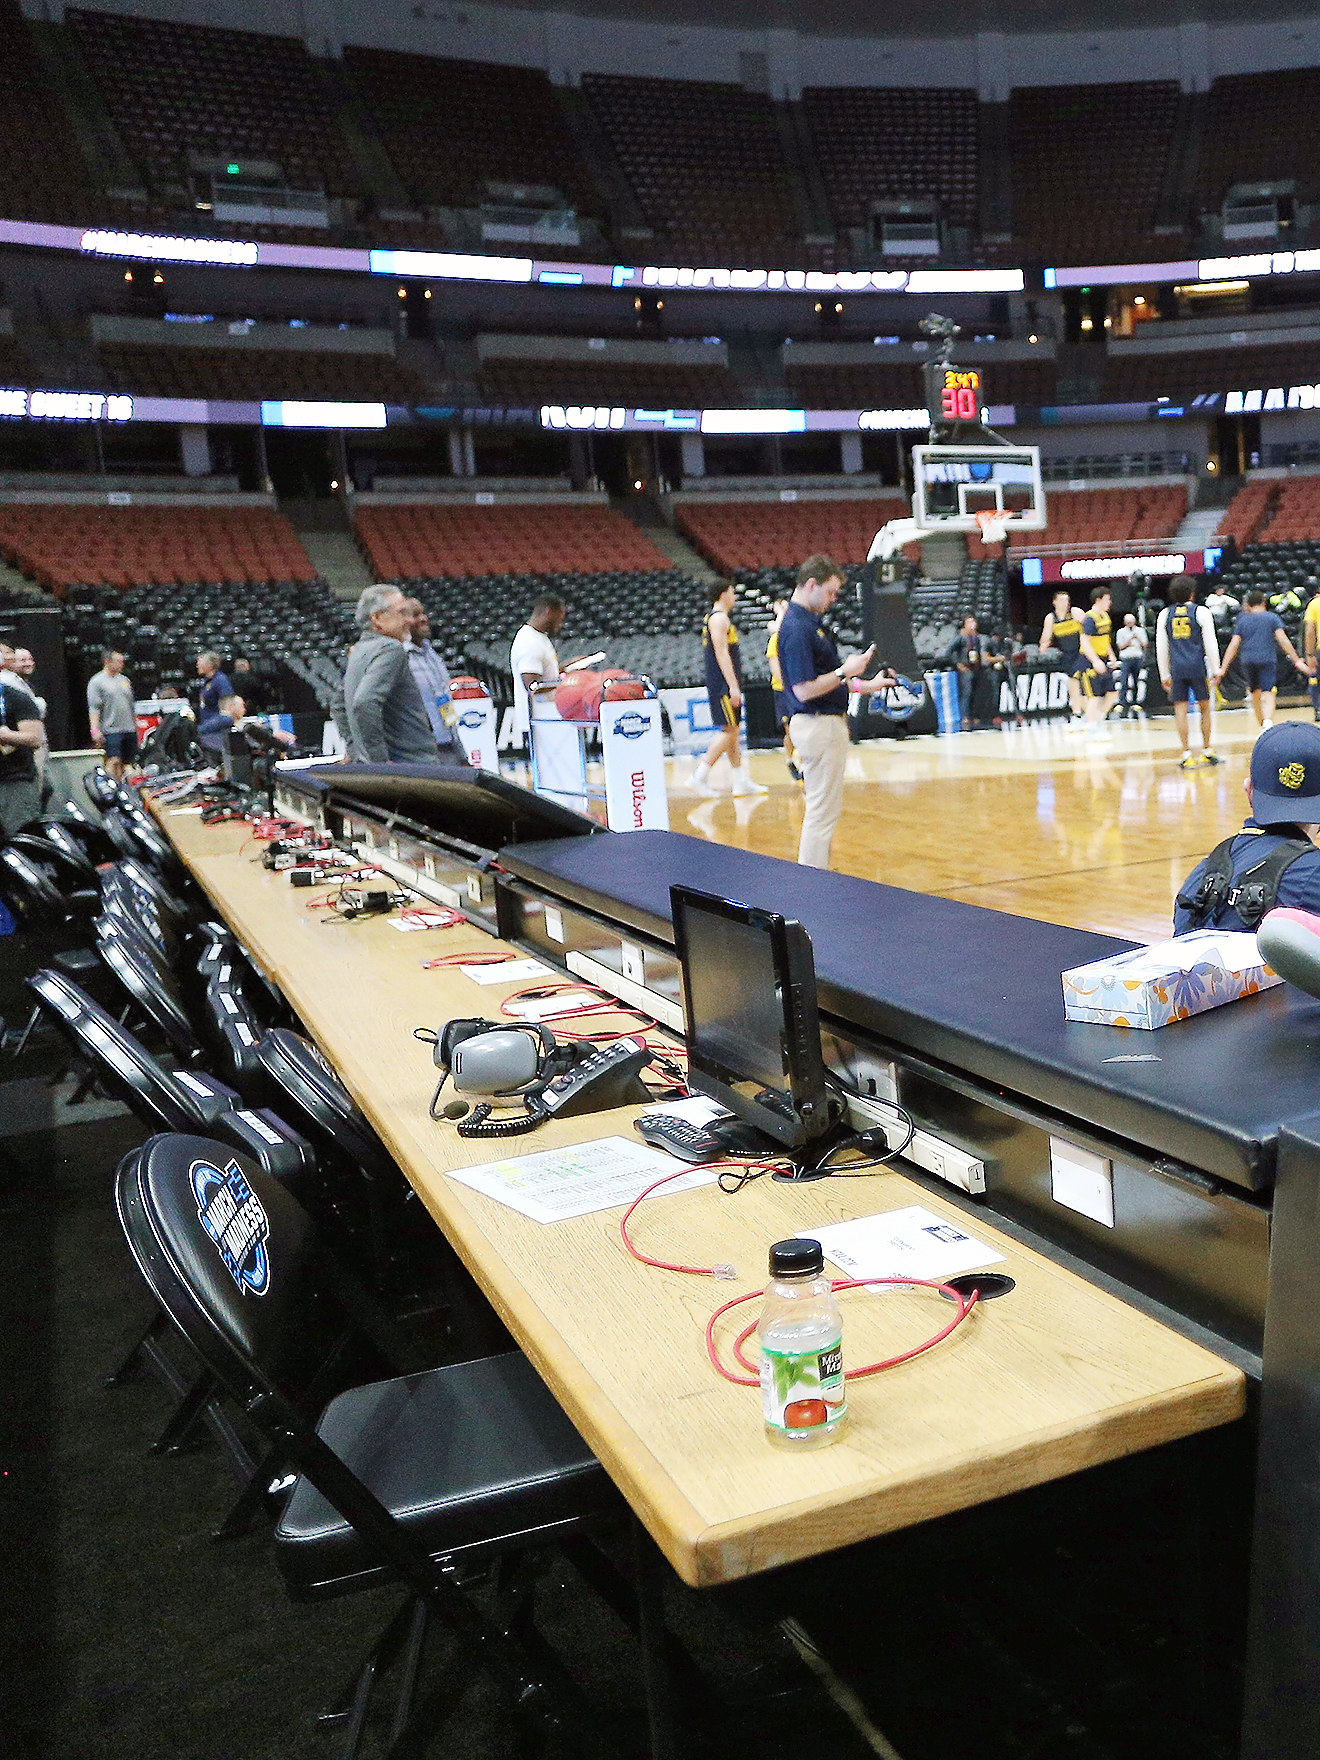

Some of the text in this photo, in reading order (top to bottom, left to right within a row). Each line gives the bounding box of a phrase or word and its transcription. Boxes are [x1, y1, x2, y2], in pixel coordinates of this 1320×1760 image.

[941, 388, 976, 419] 30
[630, 771, 646, 828] Wilson
[205, 1183, 239, 1237] MARCH
[222, 1194, 266, 1263] MADNESS
